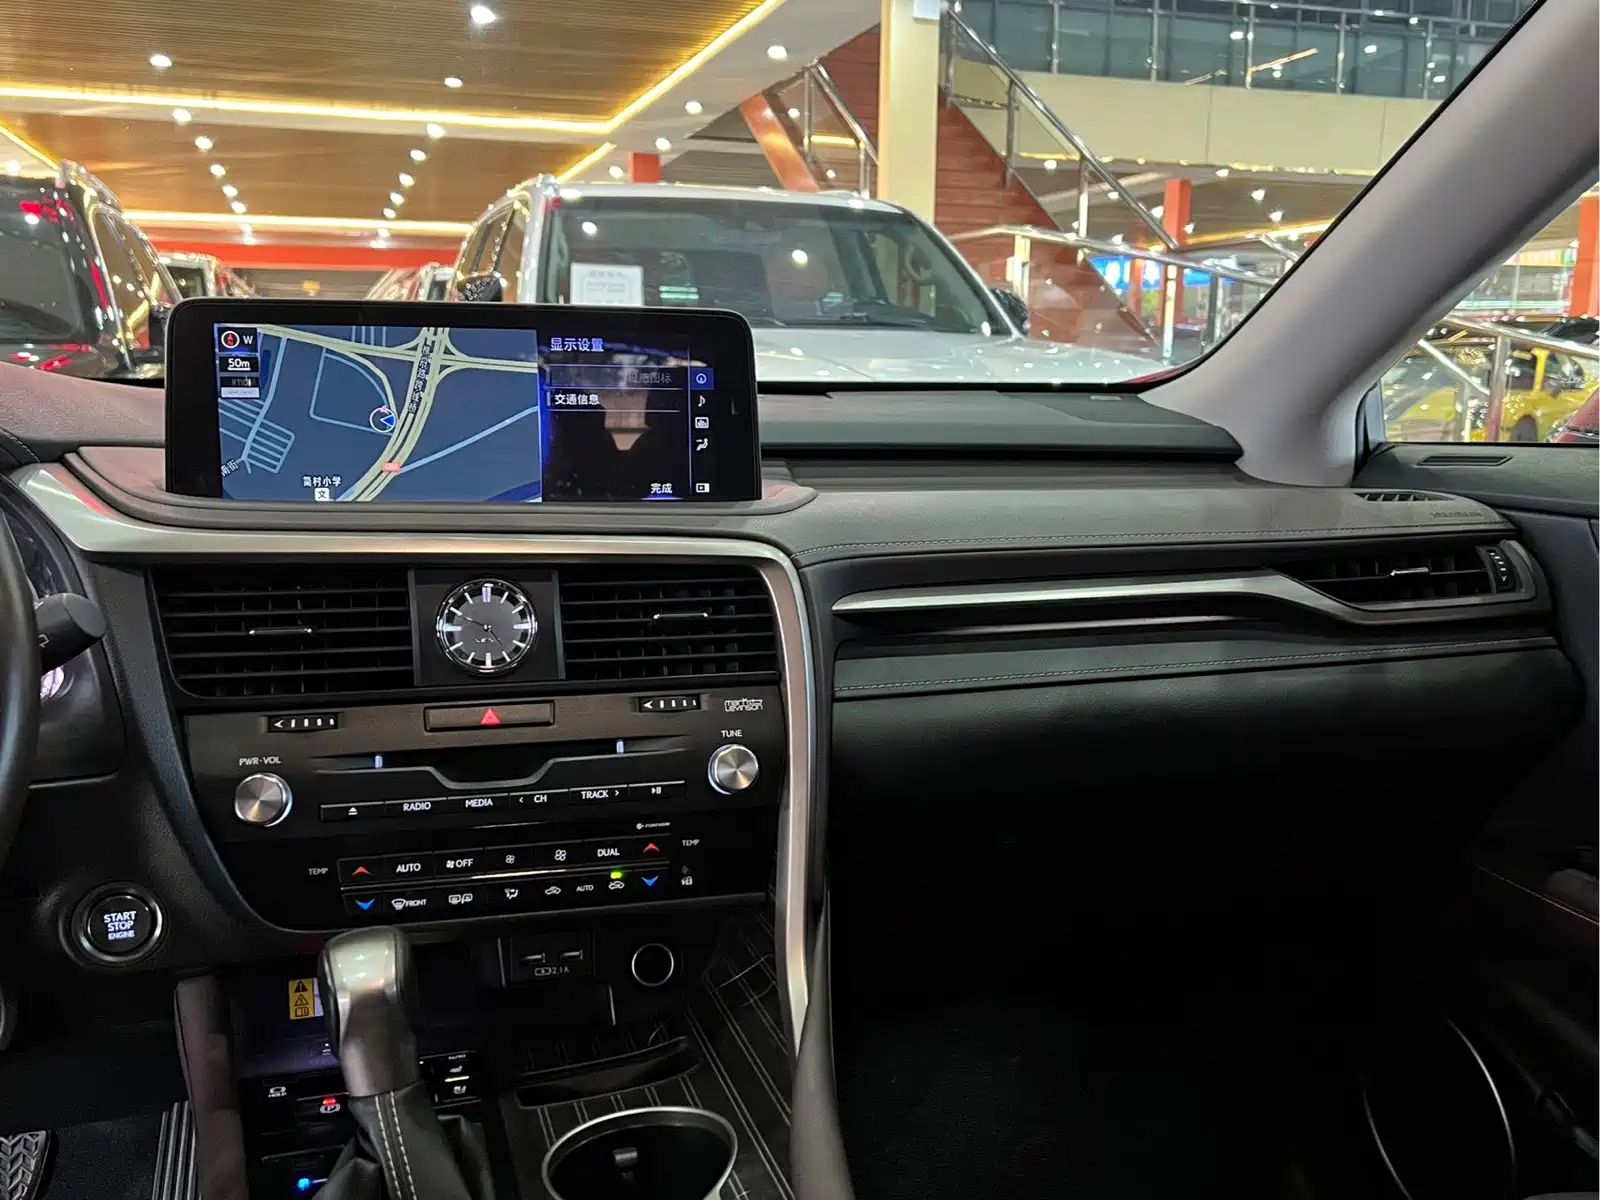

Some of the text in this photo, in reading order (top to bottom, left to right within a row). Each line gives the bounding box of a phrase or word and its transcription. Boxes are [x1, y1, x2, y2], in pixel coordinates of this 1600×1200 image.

[243, 335, 253, 344] W
[550, 337, 604, 352] 显示设置
[228, 358, 250, 368] 50m
[554, 394, 600, 405] 交通信息
[650, 482, 673, 494] 完成
[720, 729, 743, 738] TUNE
[533, 794, 547, 803] CH
[580, 789, 609, 799] TRACK
[403, 801, 431, 812] RADIO
[465, 798, 493, 808] MEDIA
[597, 847, 620, 857] DUAL
[396, 863, 421, 873] AUTO
[455, 858, 474, 868] OFF
[308, 866, 328, 876] TEMP
[576, 884, 594, 892] AUTO
[405, 898, 427, 908] FRONT
[103, 910, 137, 923] START
[107, 920, 134, 932] STOP
